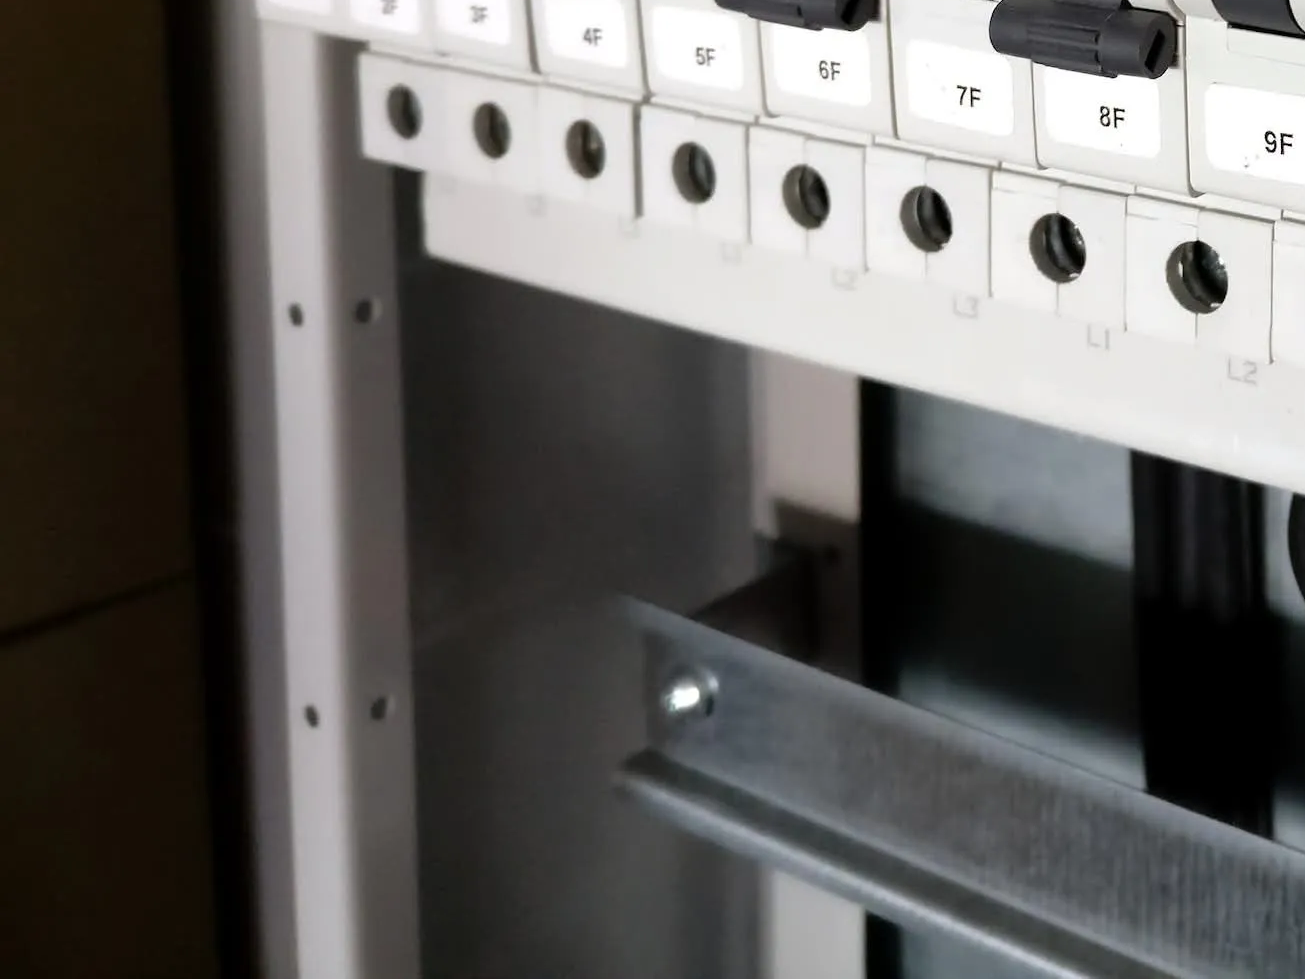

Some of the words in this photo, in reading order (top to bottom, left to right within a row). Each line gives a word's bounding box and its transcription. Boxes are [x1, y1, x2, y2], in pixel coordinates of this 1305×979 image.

[583, 27, 602, 46] 4F
[695, 47, 716, 67] 5F
[819, 60, 841, 81] 6F
[956, 84, 982, 108] 7F
[1099, 105, 1126, 128] 8F
[1263, 130, 1294, 155] 9F
[1087, 323, 1111, 350] L1
[1227, 358, 1258, 384] L2
